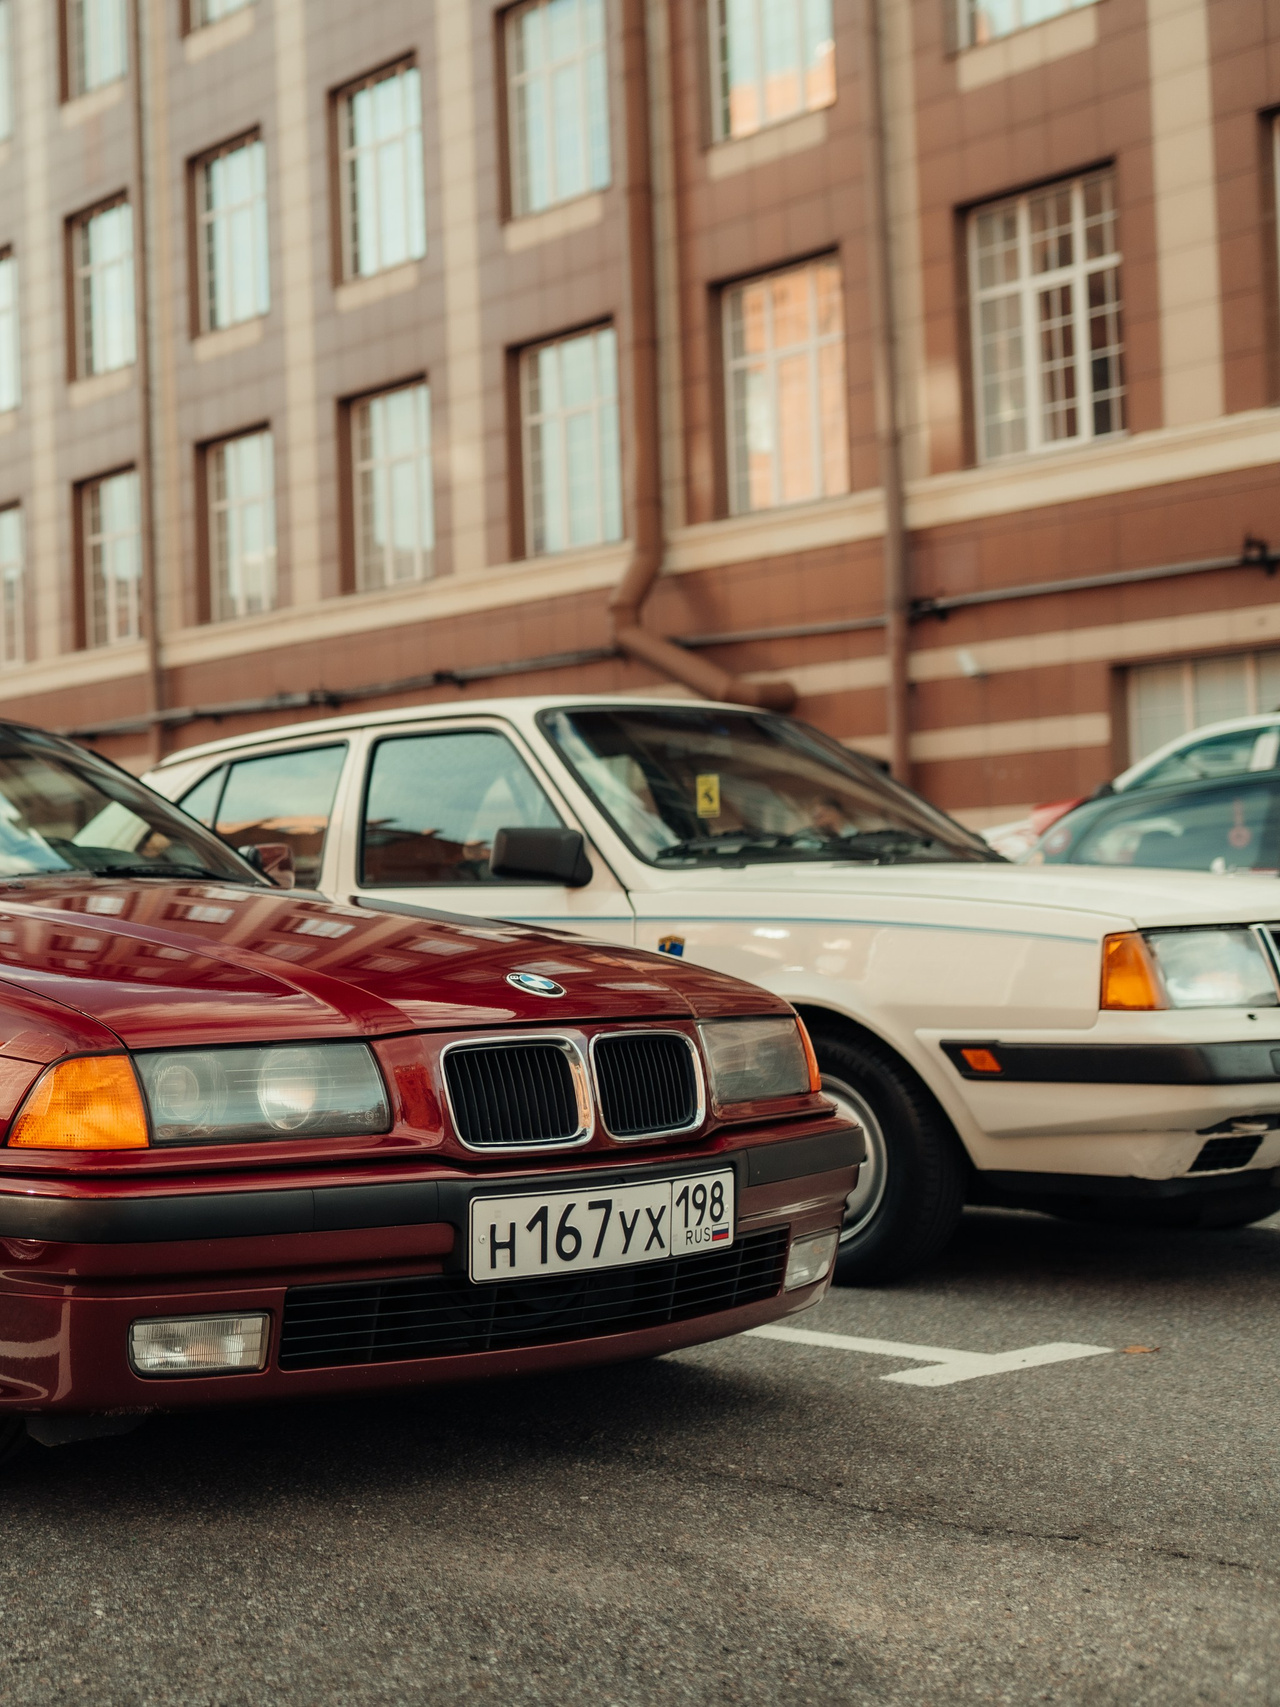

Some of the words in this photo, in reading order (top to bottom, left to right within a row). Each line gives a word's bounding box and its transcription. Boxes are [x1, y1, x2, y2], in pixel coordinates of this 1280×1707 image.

[490, 1199, 667, 1269] Н167УХ
[676, 1180, 724, 1228] 198
[686, 1227, 711, 1246] RUS
